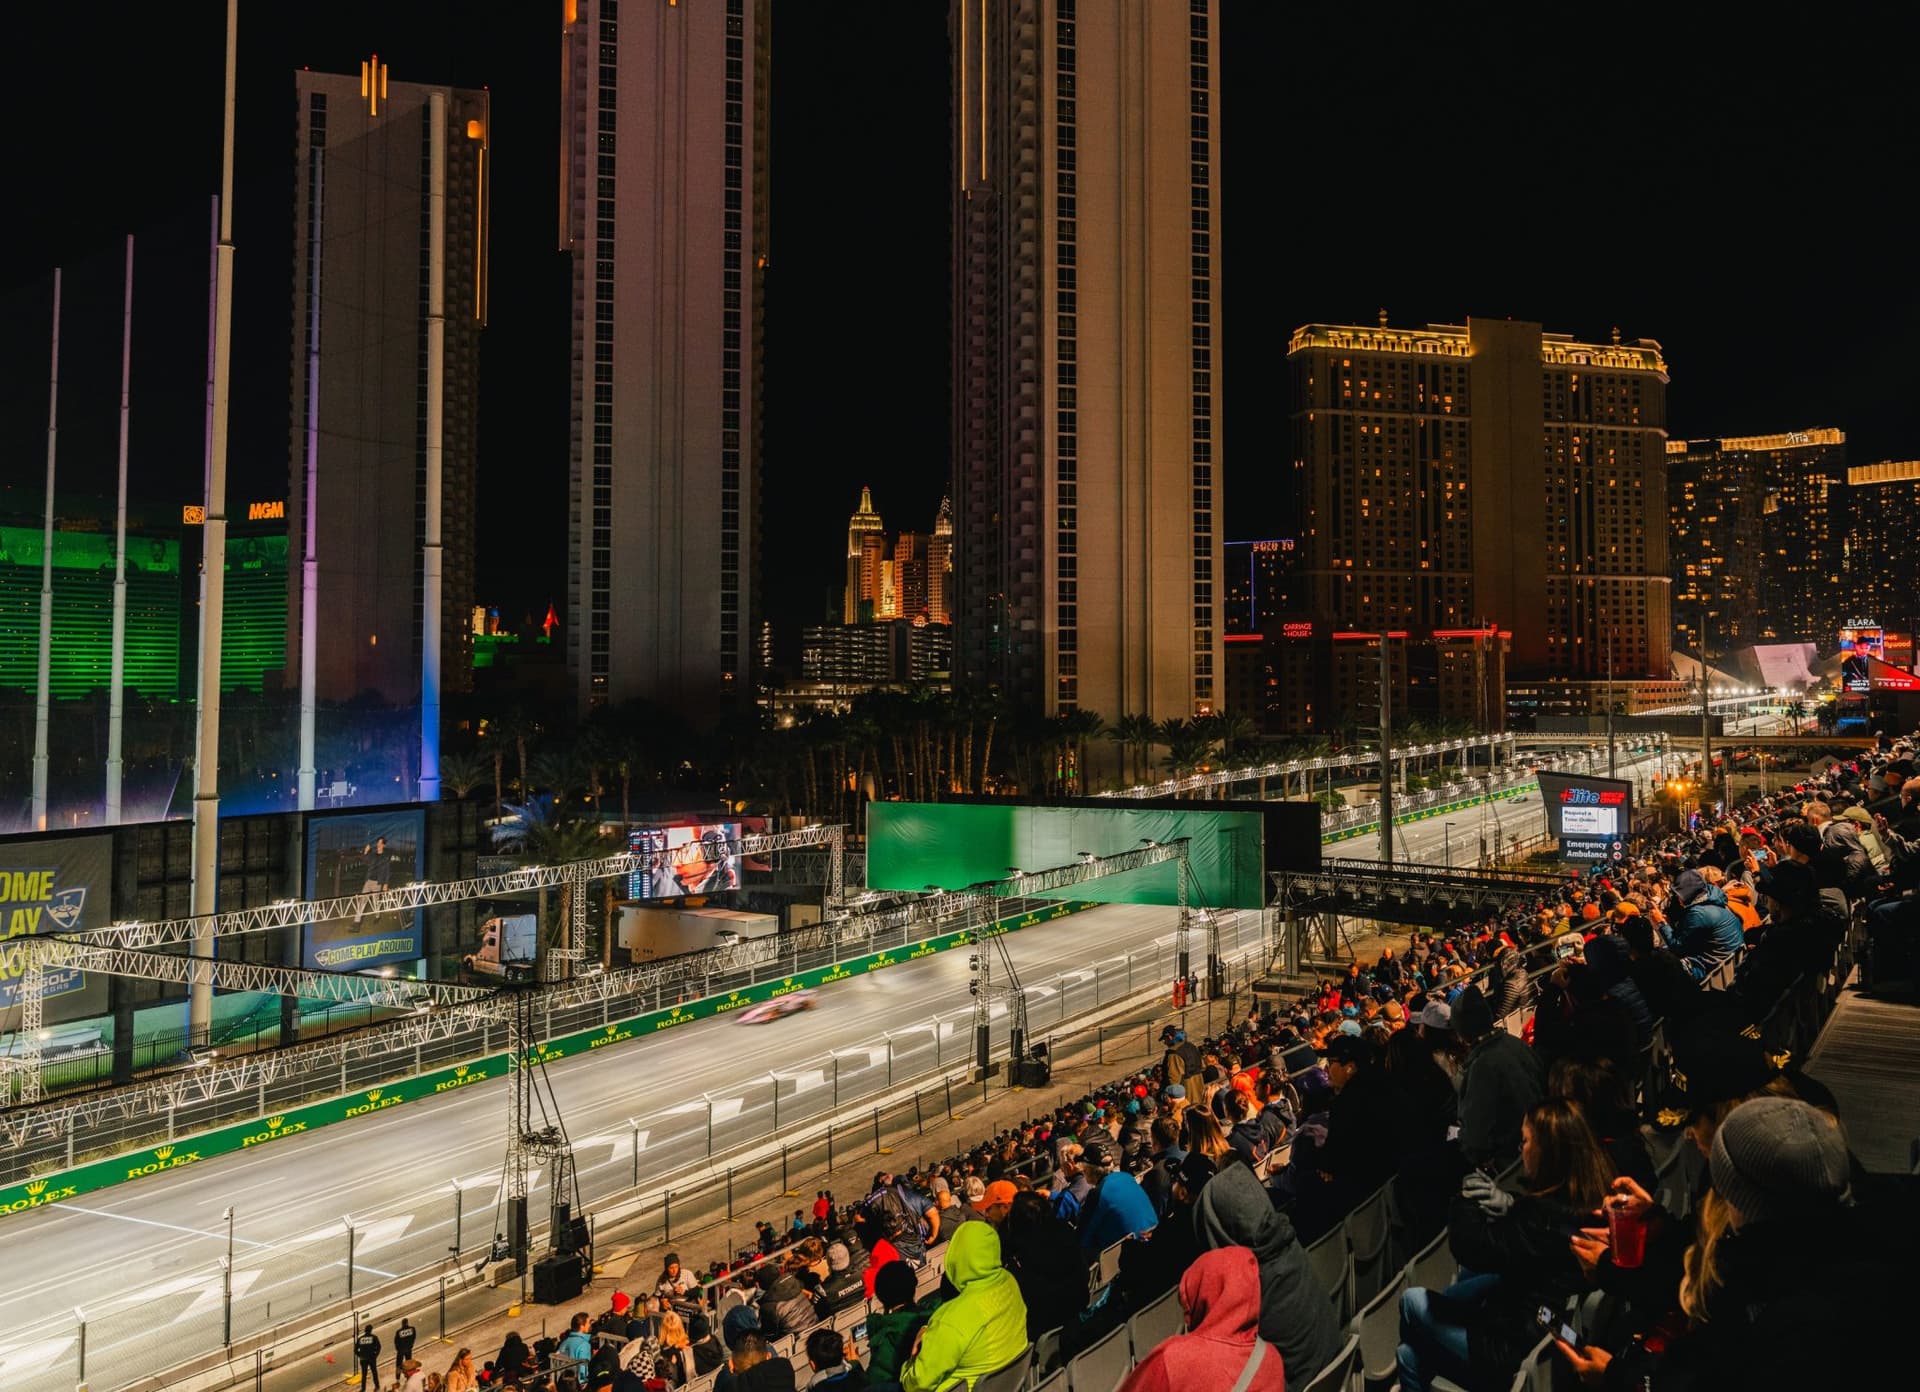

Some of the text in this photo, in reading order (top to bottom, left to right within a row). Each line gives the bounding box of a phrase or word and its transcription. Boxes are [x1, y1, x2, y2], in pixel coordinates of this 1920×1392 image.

[248, 500, 285, 521] MGM
[1847, 618, 1876, 627] ELARA
[1287, 630, 1309, 638] HOUSE
[1563, 787, 1600, 804] Elite
[1566, 840, 1608, 850] Emergency
[1566, 850, 1608, 859] Ambulance
[328, 939, 413, 964] COME PLAY AROUND
[910, 947, 937, 959] ROLEX
[868, 957, 896, 971] ROLEX
[3, 970, 79, 997] TOGOLF
[821, 970, 852, 984] ROLEX
[771, 983, 804, 998] ROLEX
[716, 997, 752, 1013] ROLEX
[656, 1012, 695, 1031] ROLEX
[590, 1030, 633, 1049] ROLEX
[435, 1071, 488, 1093] ROLEX
[345, 1094, 404, 1120] ROLEX
[242, 1120, 308, 1149] ROLEX
[127, 1150, 201, 1179] ROLEX
